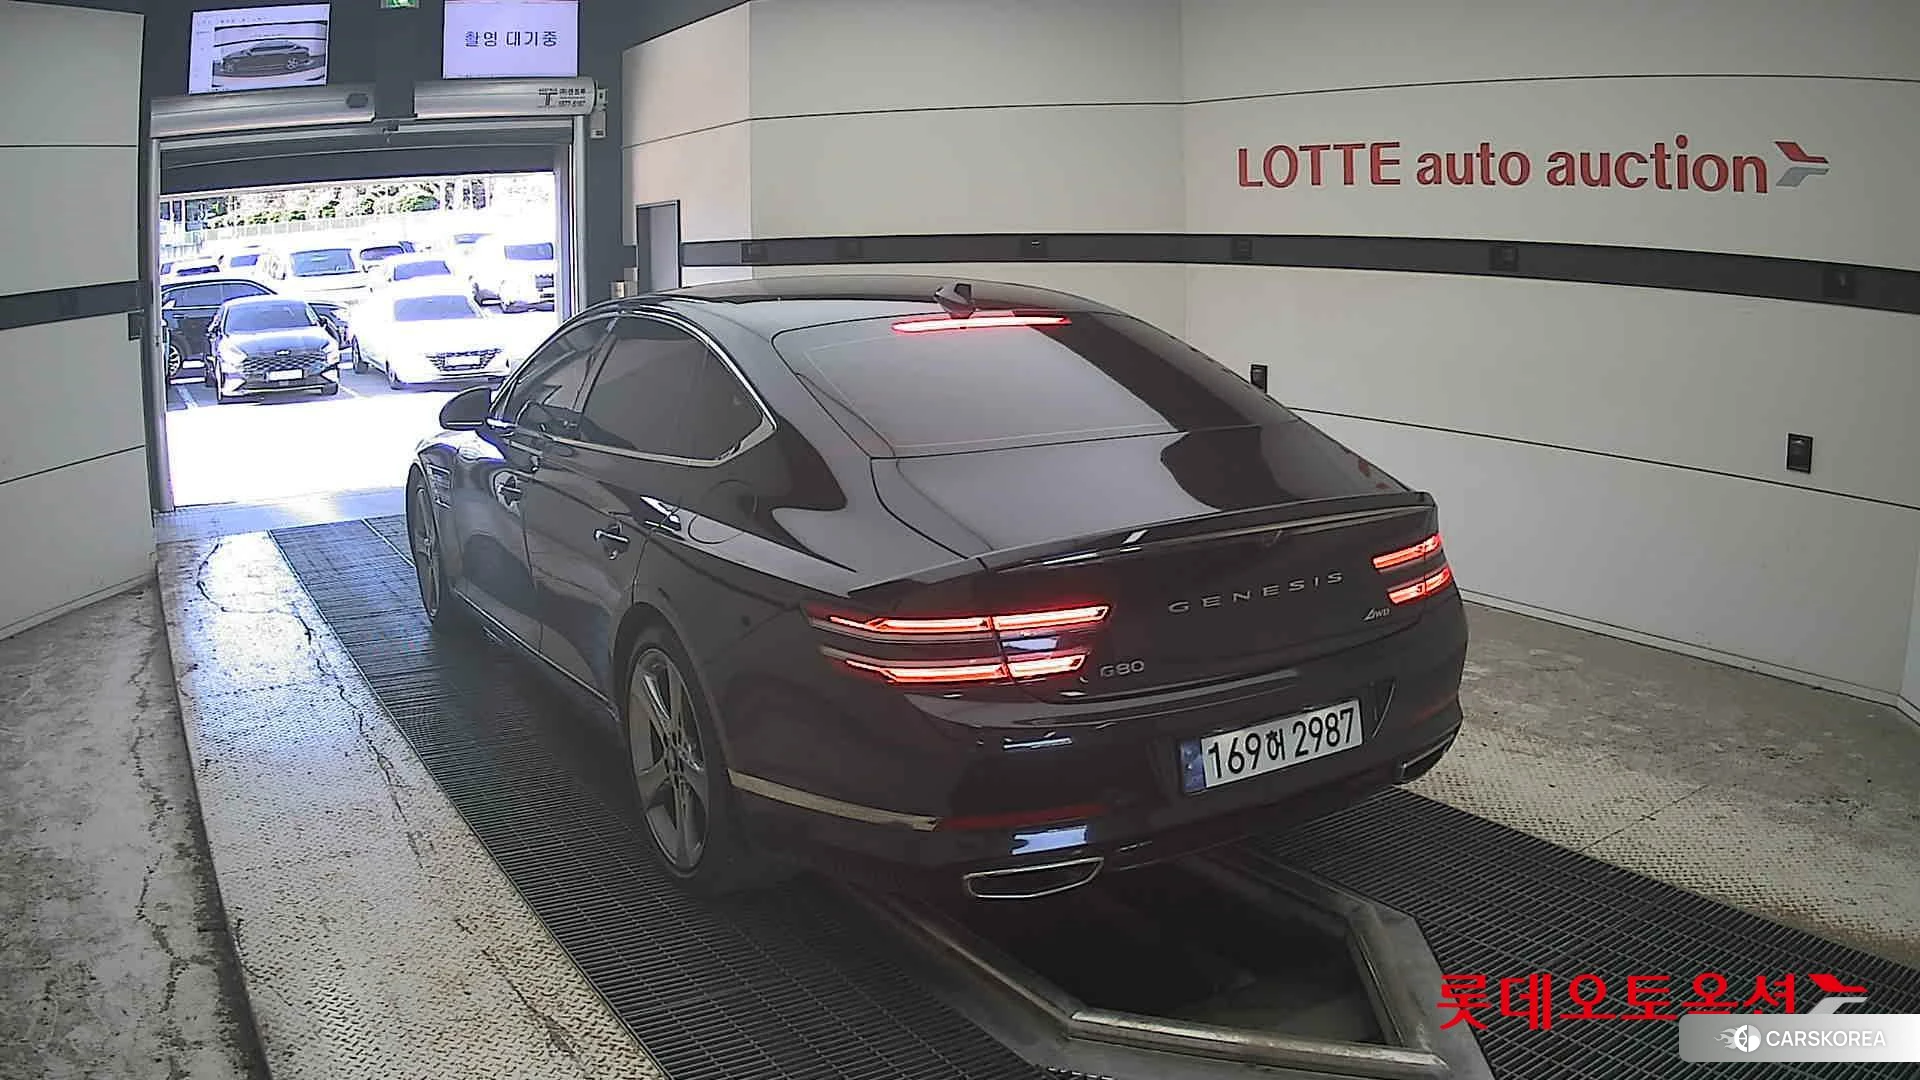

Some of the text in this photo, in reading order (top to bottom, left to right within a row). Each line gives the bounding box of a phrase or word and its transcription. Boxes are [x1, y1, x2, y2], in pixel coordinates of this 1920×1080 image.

[506, 31, 558, 48] 대기중
[1237, 135, 1768, 193] LOTTE auto auction
[1167, 570, 1344, 614] GENESIS
[1099, 659, 1145, 678] G80
[1207, 729, 1286, 779] 169허
[1292, 707, 1355, 759] 2987
